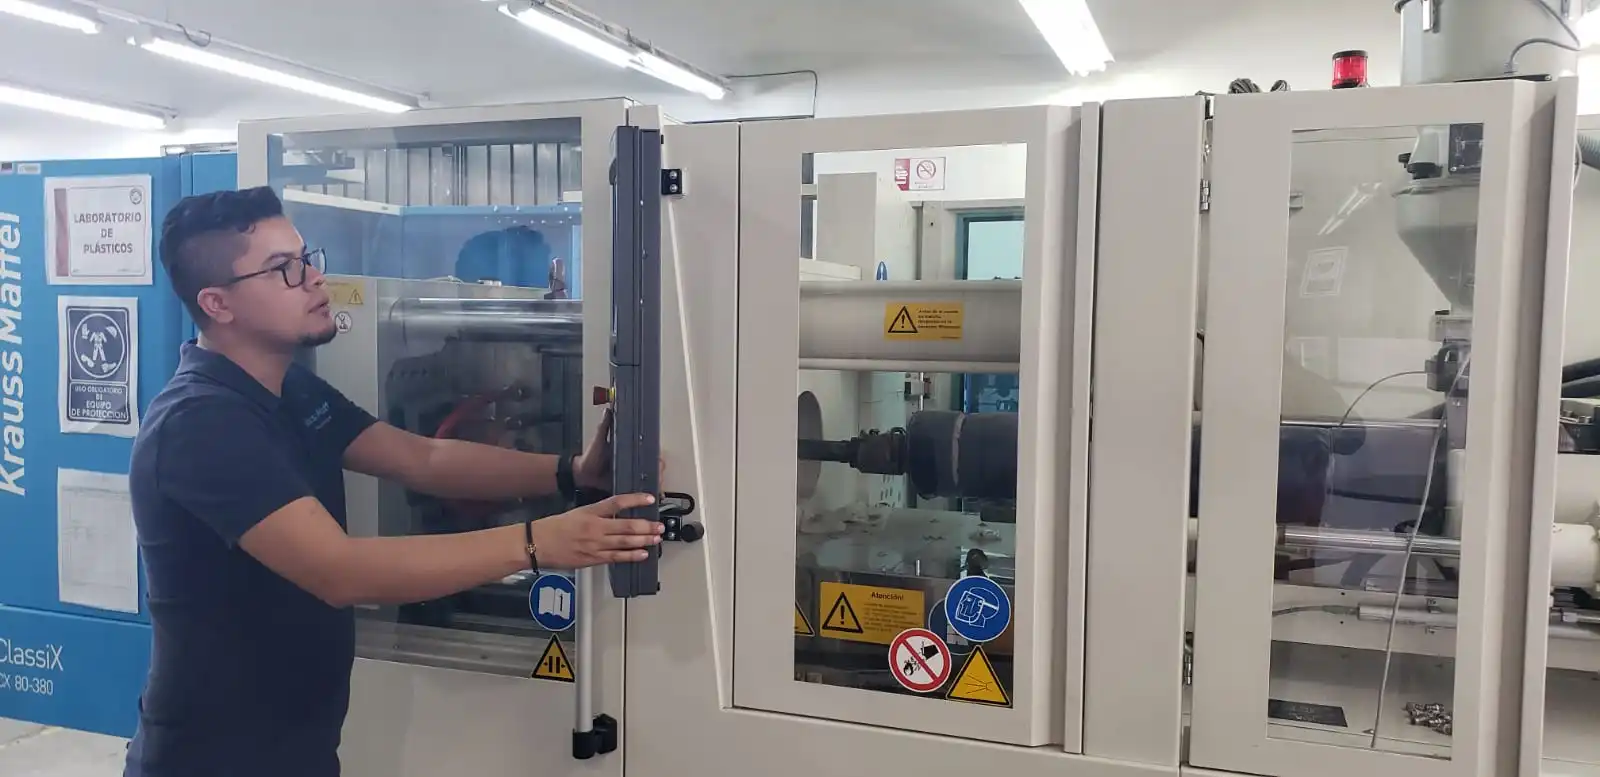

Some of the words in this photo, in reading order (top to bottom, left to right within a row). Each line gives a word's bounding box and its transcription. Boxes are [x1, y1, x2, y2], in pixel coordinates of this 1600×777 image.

[74, 212, 142, 224] LABORATORIO
[100, 228, 113, 238] DE
[83, 240, 133, 254] PLÁSTICOS
[75, 385, 87, 393] USO
[87, 385, 123, 394] OBLIGATORIO
[86, 400, 112, 410] EQUIPO
[71, 408, 81, 417] DE
[15, 674, 54, 696] 80-380
